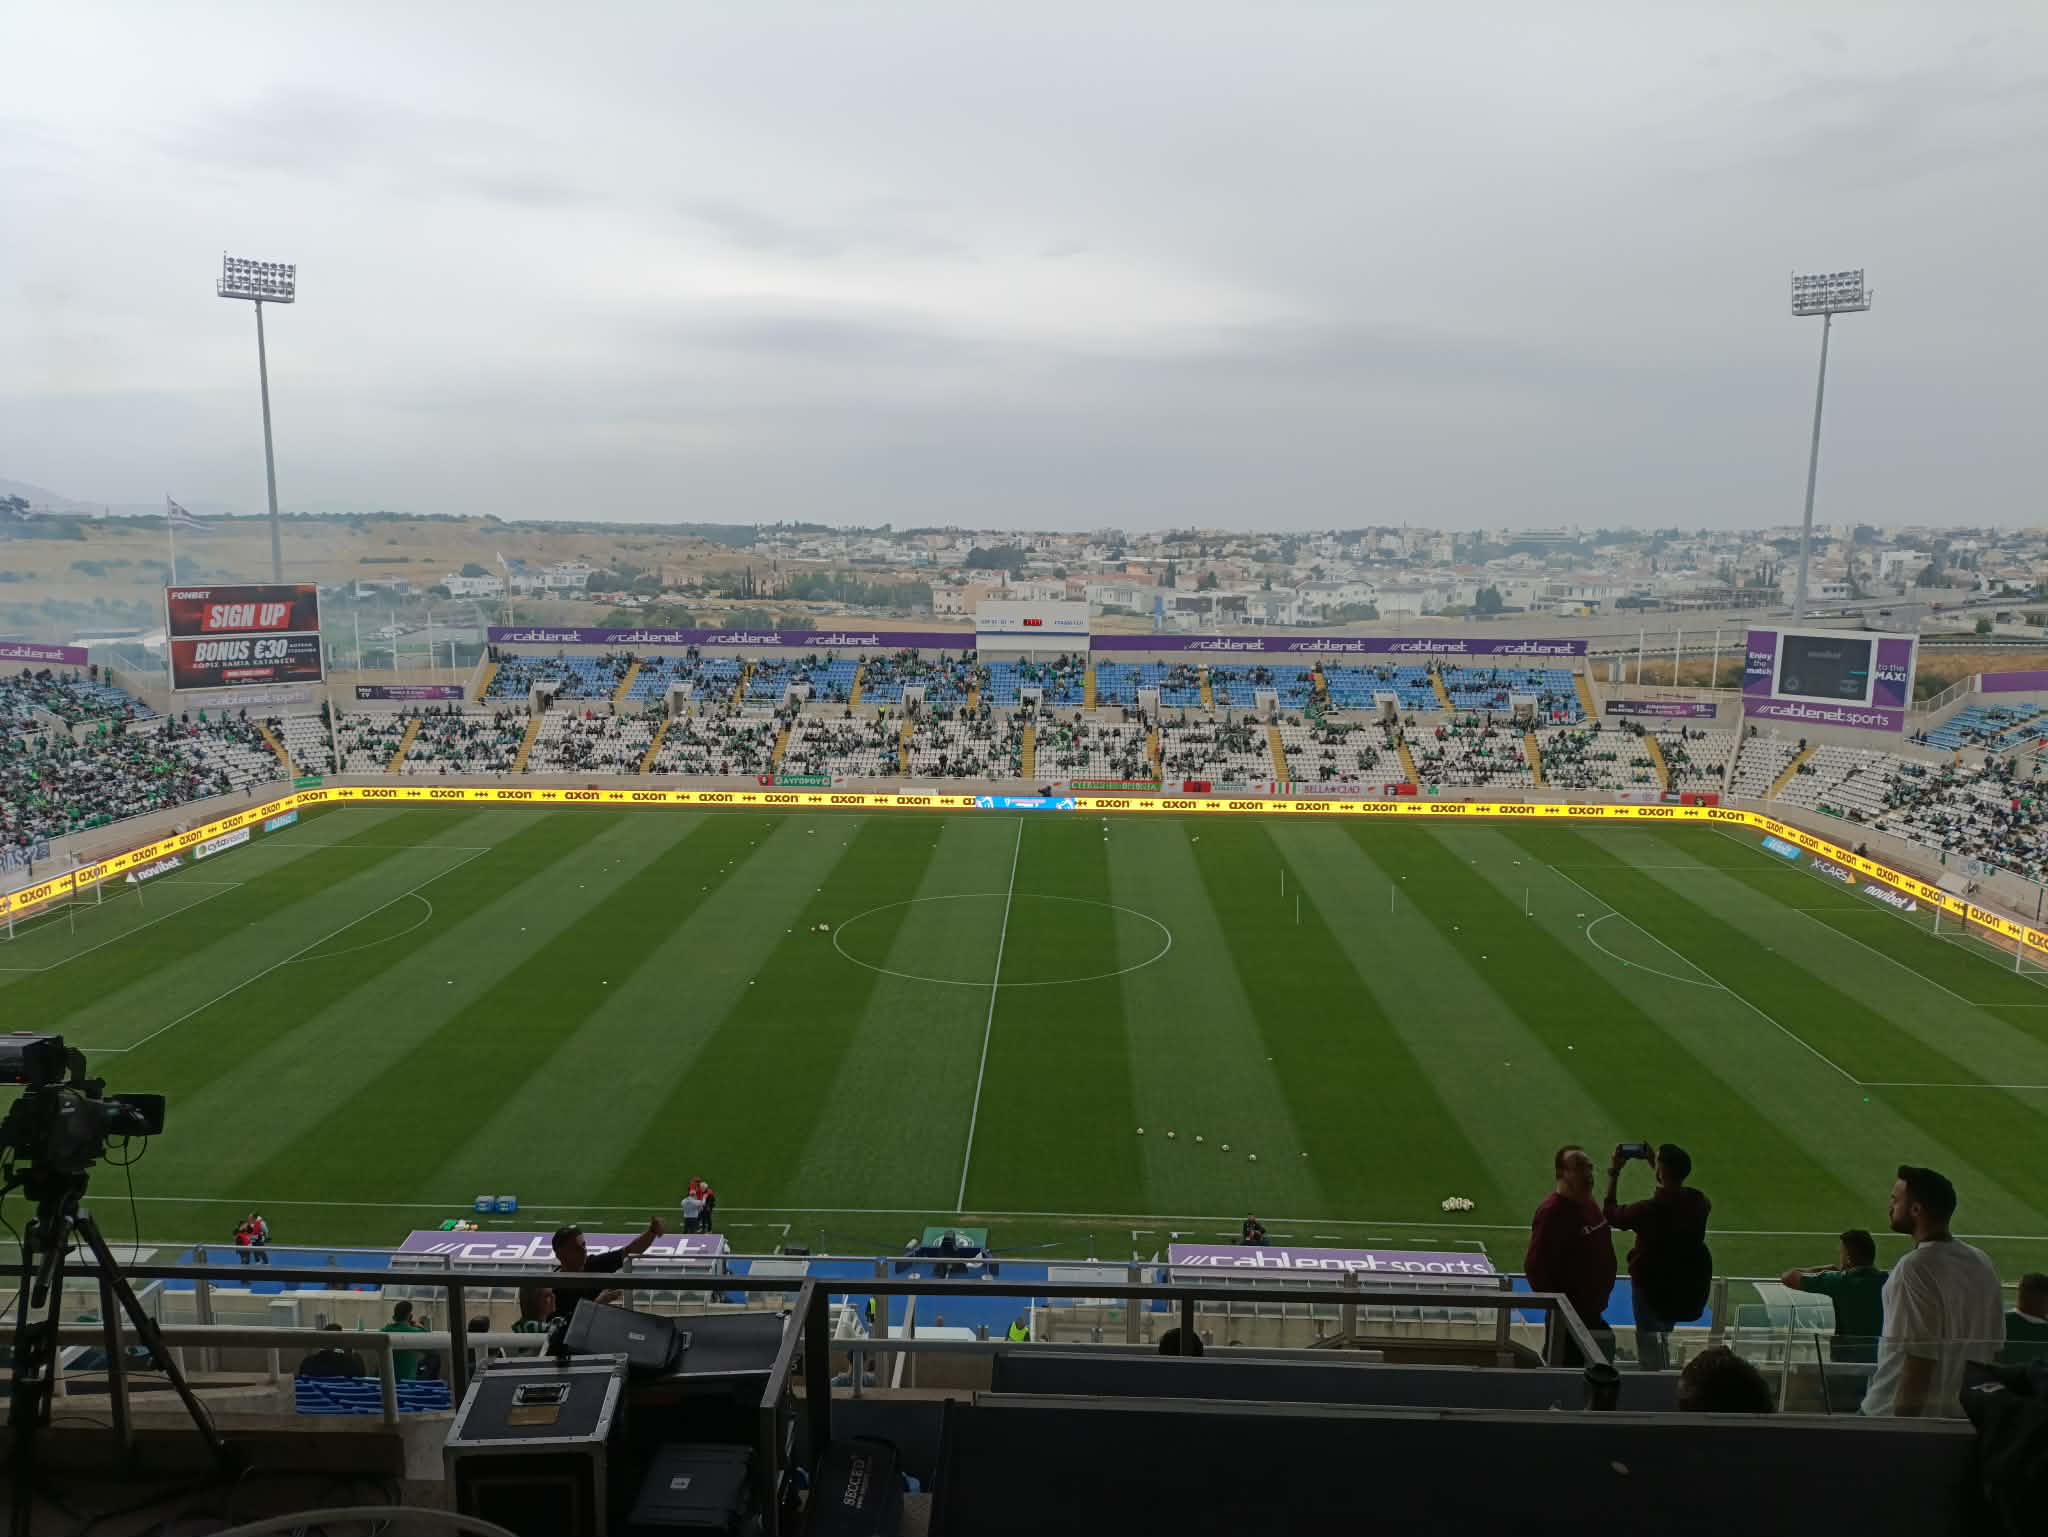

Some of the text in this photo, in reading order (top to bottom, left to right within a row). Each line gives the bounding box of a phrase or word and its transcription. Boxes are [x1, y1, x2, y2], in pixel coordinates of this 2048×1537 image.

[171, 591, 211, 600] FONBET
[209, 603, 286, 629] SIGN UP
[513, 630, 581, 642] cablenet
[617, 631, 683, 643] cablenet
[718, 632, 781, 644] cablenet
[816, 633, 879, 645] cablenet
[1200, 638, 1264, 650] cablenet
[1301, 640, 1364, 651] cablenet
[1401, 640, 1467, 652] cablenet
[1505, 641, 1575, 654] cablenet
[195, 639, 288, 662] BONUS €30
[1749, 652, 1772, 660] Enjoy
[1746, 667, 1772, 675] match
[1889, 664, 1904, 672] the
[1875, 671, 1906, 682] MAX!
[296, 789, 328, 804] axon
[362, 789, 396, 798] axon
[430, 790, 464, 798] axon
[497, 790, 531, 799] axon
[564, 791, 599, 800] axon
[632, 792, 666, 801] axon
[698, 793, 732, 802] axon
[764, 794, 799, 803] axon
[830, 795, 864, 804] axon
[896, 796, 930, 805] axon
[1095, 799, 1129, 808] axon
[1162, 800, 1196, 809] axon
[1228, 801, 1262, 810] axon
[1295, 802, 1329, 811] axon
[1362, 803, 1397, 812] axon
[1430, 804, 1465, 813] axon
[1499, 805, 1534, 814] axon
[1568, 807, 1603, 816] axon
[1638, 808, 1673, 817] axon
[1707, 809, 1744, 820] axon
[207, 830, 248, 852] cytavision
[20, 802, 281, 905] axon axon axon axon axon axon
[138, 856, 181, 880] novibet
[1812, 857, 1848, 881] X-CARS
[1766, 821, 1784, 834] axon
[1799, 834, 1819, 848] axon
[1836, 850, 1857, 866] axon
[1876, 867, 1899, 884] axon
[1920, 886, 1946, 905] axon
[1971, 908, 2000, 928] axon
[1864, 885, 1908, 908] novibet
